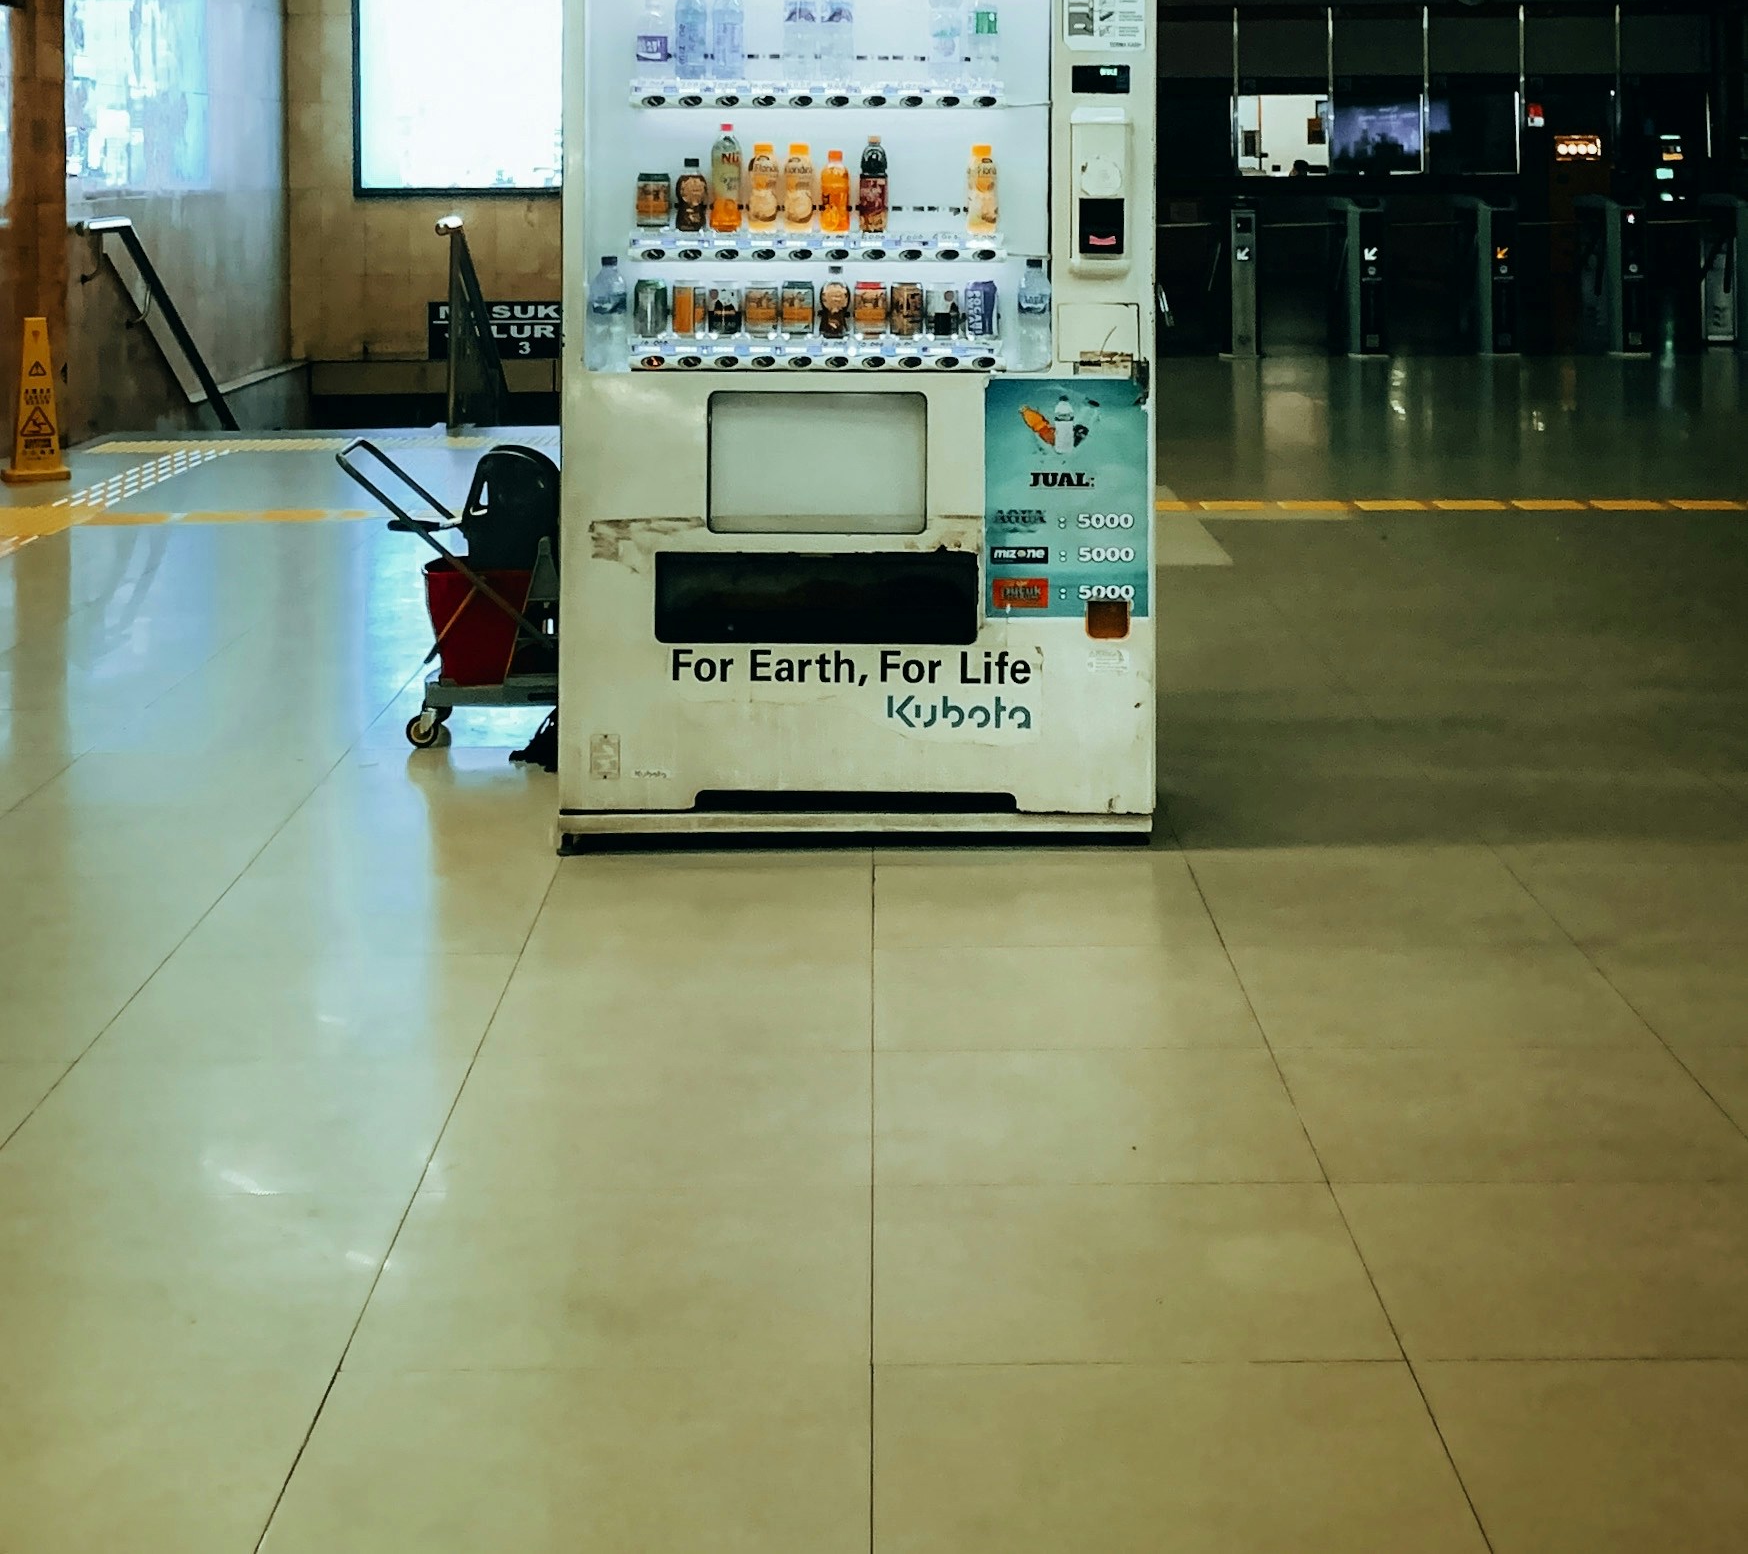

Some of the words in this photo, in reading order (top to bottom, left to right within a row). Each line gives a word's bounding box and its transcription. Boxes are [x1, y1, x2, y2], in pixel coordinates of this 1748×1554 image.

[440, 305, 559, 319] SUK
[518, 341, 531, 355] 3
[1029, 472, 1095, 487] JUAL:
[1077, 513, 1134, 529] 5000
[1077, 547, 1135, 563] 5000
[1078, 584, 1135, 600] 5000
[671, 649, 734, 682] For
[750, 649, 868, 687] Earth,
[880, 650, 942, 684] For
[960, 650, 1032, 685] Life
[887, 694, 1031, 729] Kubota
